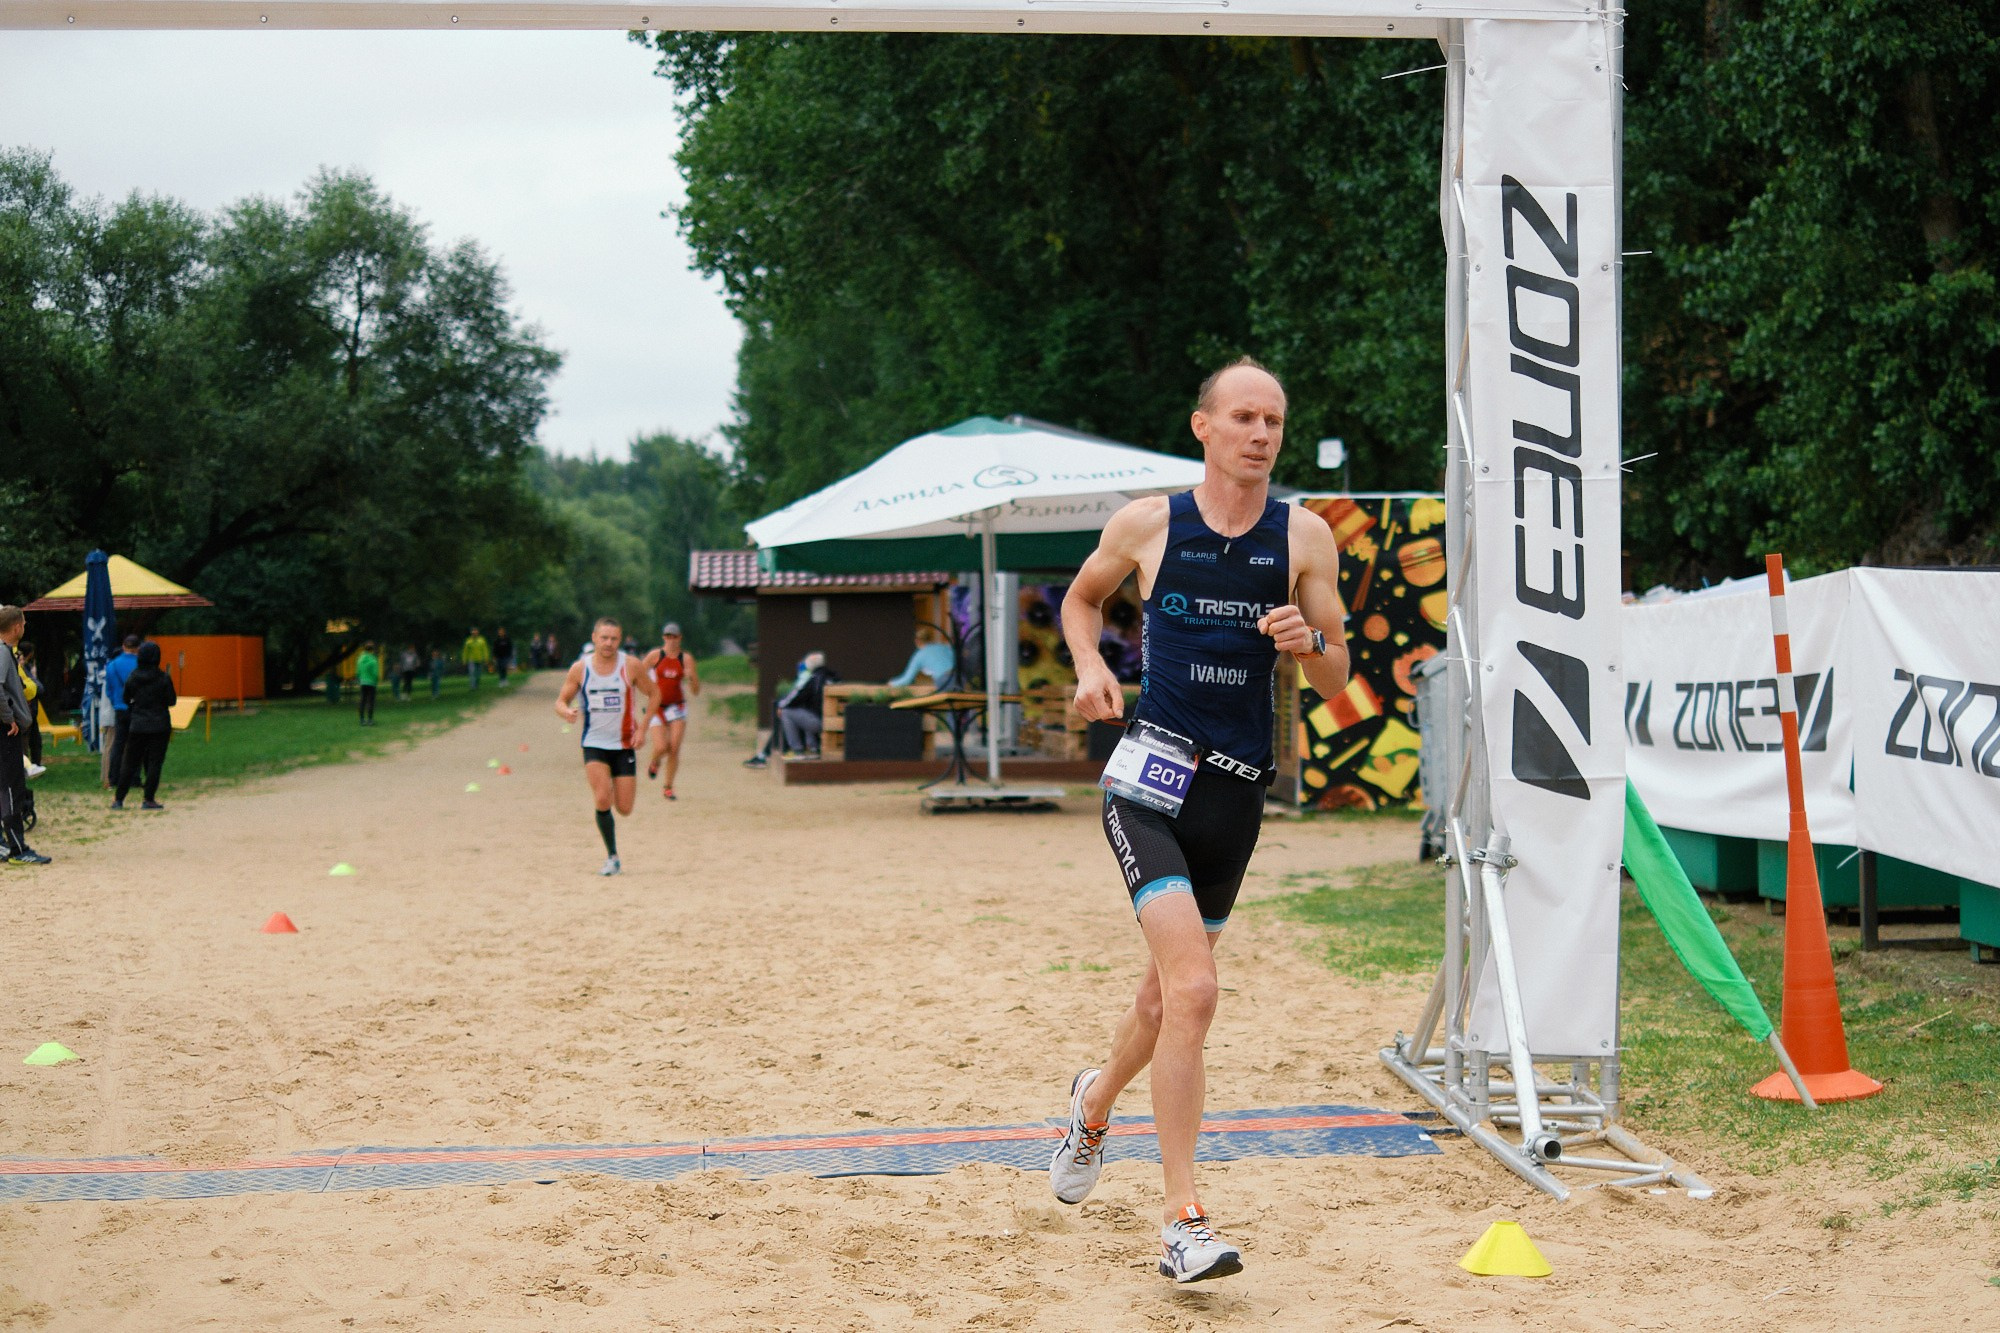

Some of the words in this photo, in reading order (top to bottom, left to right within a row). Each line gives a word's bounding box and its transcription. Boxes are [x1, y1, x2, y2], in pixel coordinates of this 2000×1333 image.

[1501, 174, 1585, 620] ZONE3
[1051, 466, 1156, 481] DARIDA
[853, 482, 965, 512] ДАРИДА
[1180, 551, 1217, 560] BELARUS
[1183, 616, 1237, 627] TRIATHLON
[1240, 620, 1258, 629] TEA
[1190, 663, 1248, 686] IVANOU
[1885, 668, 2000, 778] ZON
[1147, 763, 1187, 791] 201
[1205, 750, 1262, 782] ZONE3
[1107, 804, 1141, 888] TRISTYLE
